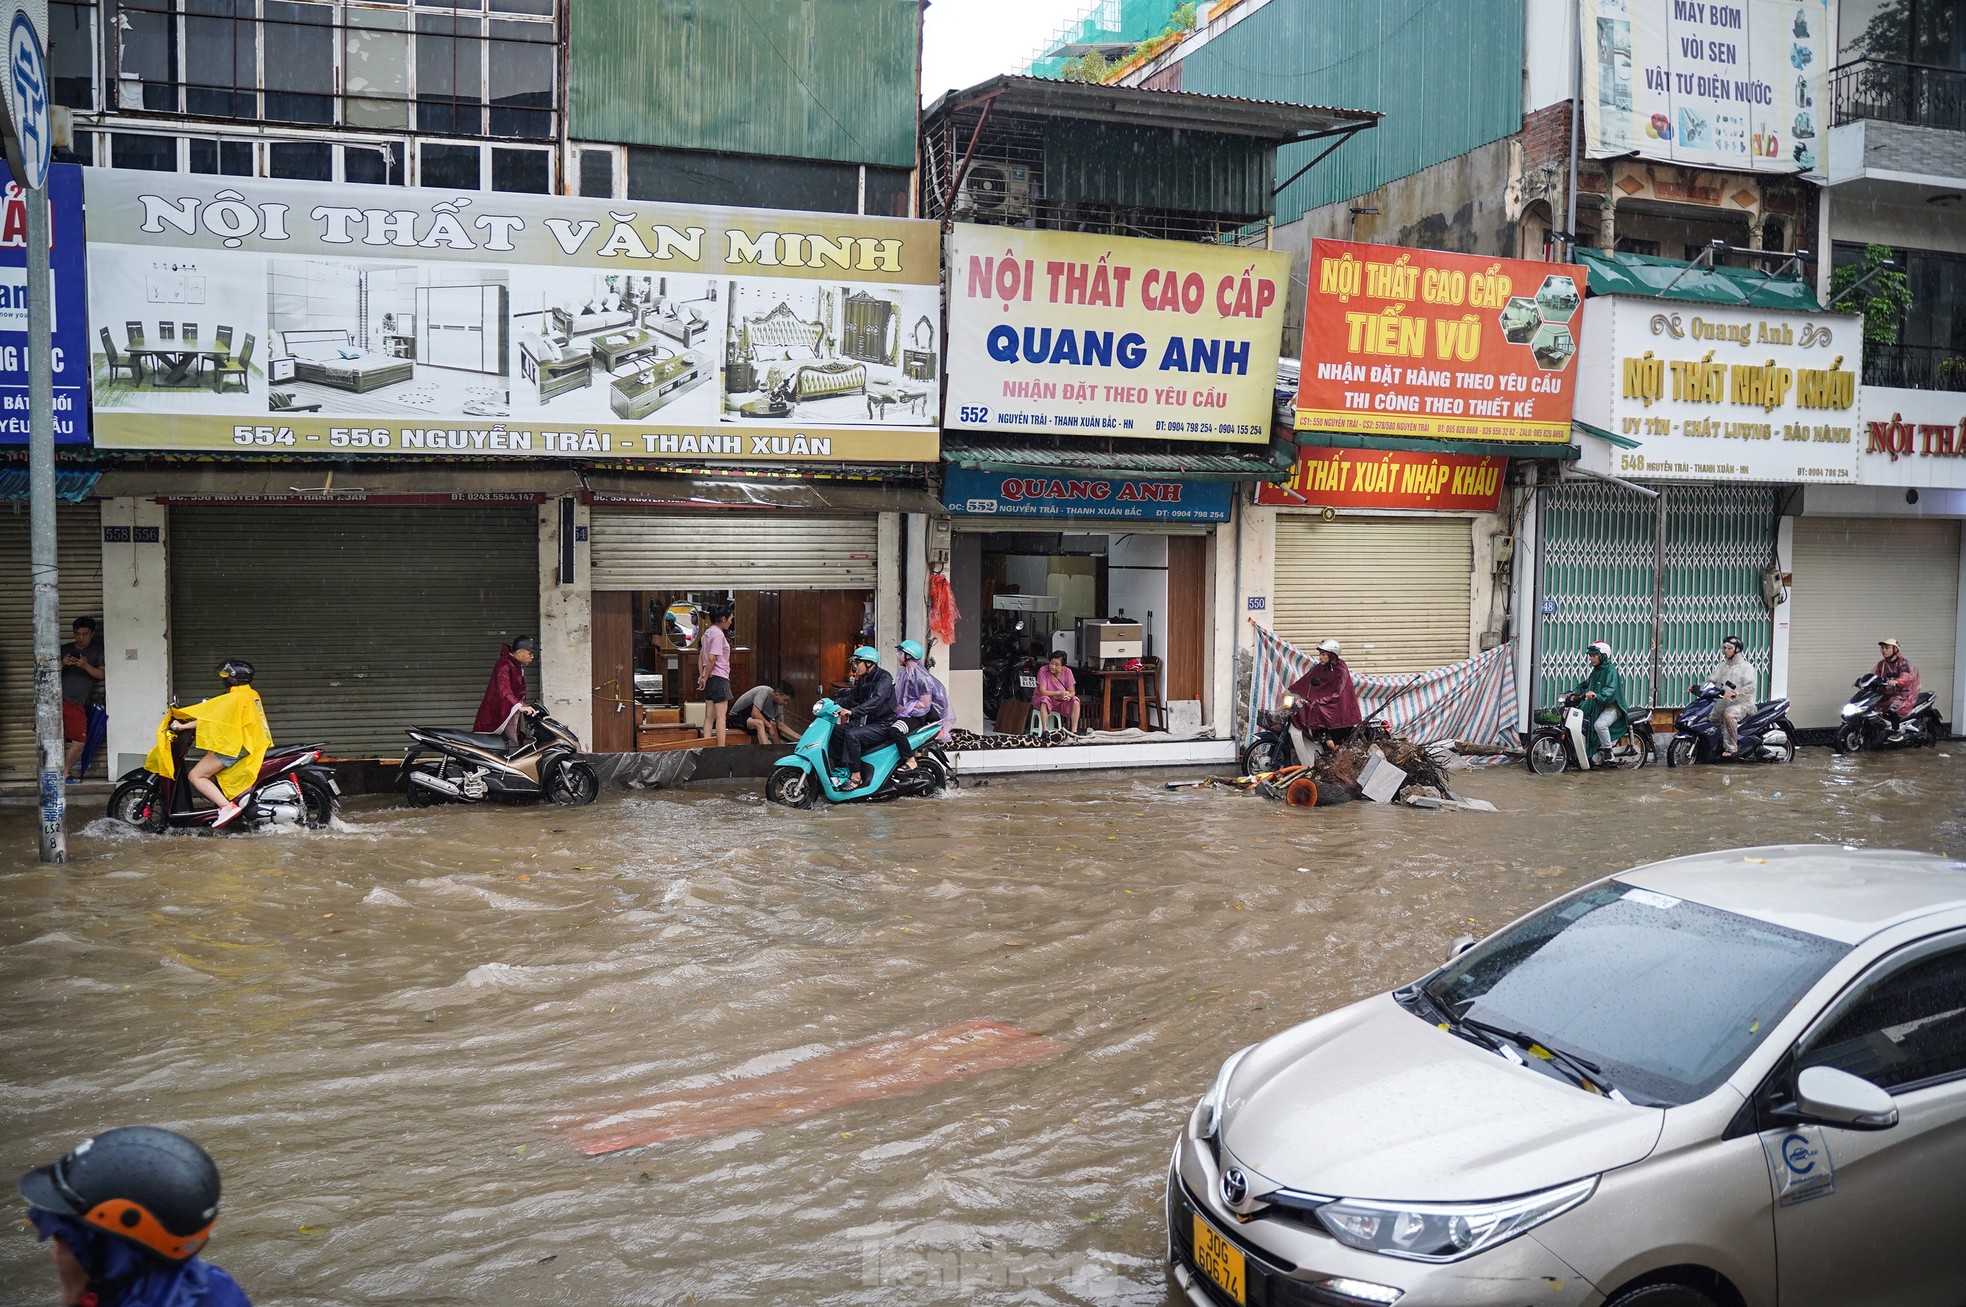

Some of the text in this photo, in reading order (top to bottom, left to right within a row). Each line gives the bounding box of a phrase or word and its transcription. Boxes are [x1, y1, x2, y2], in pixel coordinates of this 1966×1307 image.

[1710, 5, 1741, 29] BƠM
[1681, 33, 1736, 65] VÒI SEN
[1645, 66, 1772, 106] VẬT TƯ ĐIỆN NƯỚC
[138, 189, 904, 272] NỘI THẤT VĂN MINH
[967, 248, 1277, 319] NỘI THẤT CAO CẤP
[1319, 252, 1512, 309] NỘI THẤT CAO CẤP
[1346, 303, 1481, 361] TIẾN VŨ
[1691, 316, 1794, 347] Quang Anh
[986, 324, 1250, 375] QUANG ANH
[1317, 361, 1562, 394] NHẬN ĐẶT HÀNG THEO YÊU CẦU
[1623, 349, 1855, 413] NỘI THẤT NHẬP KHẨU
[1002, 379, 1228, 409] NHẬN ĐẶT THEO YÊU CẦU
[1344, 391, 1536, 418] THI CÔNG THEO THIẾT KẾ
[960, 406, 988, 423] 552
[998, 411, 1028, 425] NGUYỄN
[1031, 414, 1047, 426] TRÃI
[1054, 415, 1078, 427] THANH
[1080, 415, 1100, 428] XUÂN
[1102, 414, 1116, 429] BẮC
[1123, 419, 1134, 429] HN
[1156, 421, 1166, 431] ĐT:
[1167, 421, 1184, 432] 0904
[1186, 422, 1199, 432] 798
[1200, 423, 1212, 433] 254
[1219, 424, 1235, 434] 0904
[1237, 425, 1248, 434] 155
[1250, 425, 1262, 435] 254
[1300, 417, 1312, 426] CS1:
[1313, 418, 1323, 426] 550
[1363, 420, 1374, 429] CS2:
[1622, 417, 1642, 434] UY
[1645, 416, 1671, 436] TÍN
[1684, 416, 1721, 438] CHẤT
[1724, 420, 1771, 442] LƯỢNG
[233, 425, 296, 446] 554
[330, 427, 391, 447] 556
[401, 424, 532, 450] NGUYỄN
[541, 427, 611, 452] TRÃI
[642, 434, 742, 454] THANH
[750, 434, 832, 456] XUÂN
[1866, 412, 1916, 462] NỘI
[1306, 451, 1352, 491] THẤT
[1352, 452, 1399, 493] XUẤT
[1401, 459, 1450, 501] NHẬP
[1451, 455, 1499, 496] KHẨU
[1621, 454, 1645, 471] 548
[1694, 463, 1715, 473] THANH
[467, 493, 535, 501] 0243.5544.147
[1001, 478, 1182, 502] QUANG ANH
[967, 500, 997, 513] 552
[999, 502, 1037, 513] NGUYỄN
[1038, 504, 1058, 514] TRÃI
[1066, 507, 1096, 515] THANH
[1097, 506, 1123, 516] XUÂN
[1124, 506, 1142, 516] BẮC
[1156, 509, 1224, 519] ĐT: 0904 798 254
[106, 529, 128, 540] 558
[135, 529, 157, 540] 556
[1249, 598, 1265, 609] 550
[1207, 1228, 1229, 1264] 30G
[1199, 1245, 1239, 1298] 606.74
